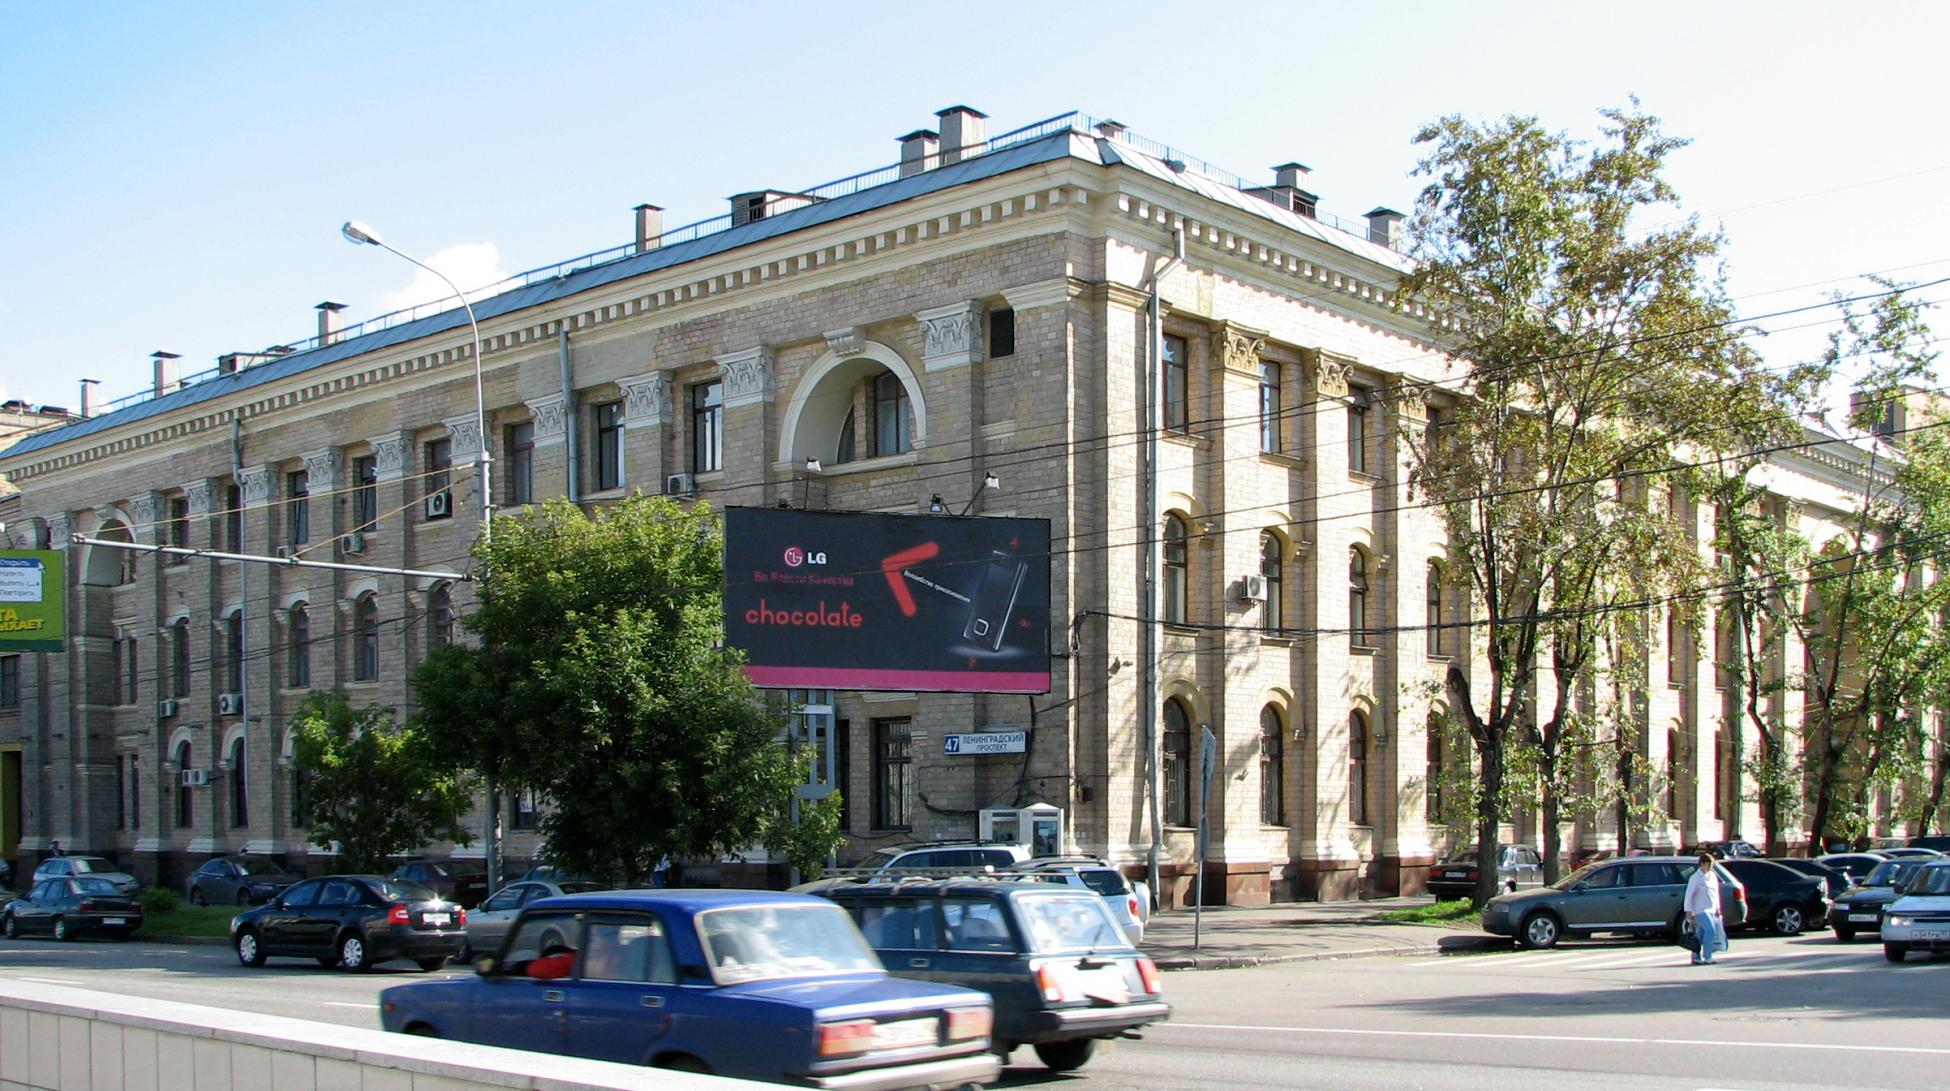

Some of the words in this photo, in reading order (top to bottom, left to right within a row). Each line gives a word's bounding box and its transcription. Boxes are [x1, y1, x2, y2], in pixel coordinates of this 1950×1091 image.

[807, 552, 827, 565] LG
[745, 598, 863, 628] chocolate
[944, 738, 960, 752] 47
[961, 733, 1024, 745] ЛЕНИНГРАДСКИЙ
[976, 743, 1008, 752] ПРОСПЕКТ
